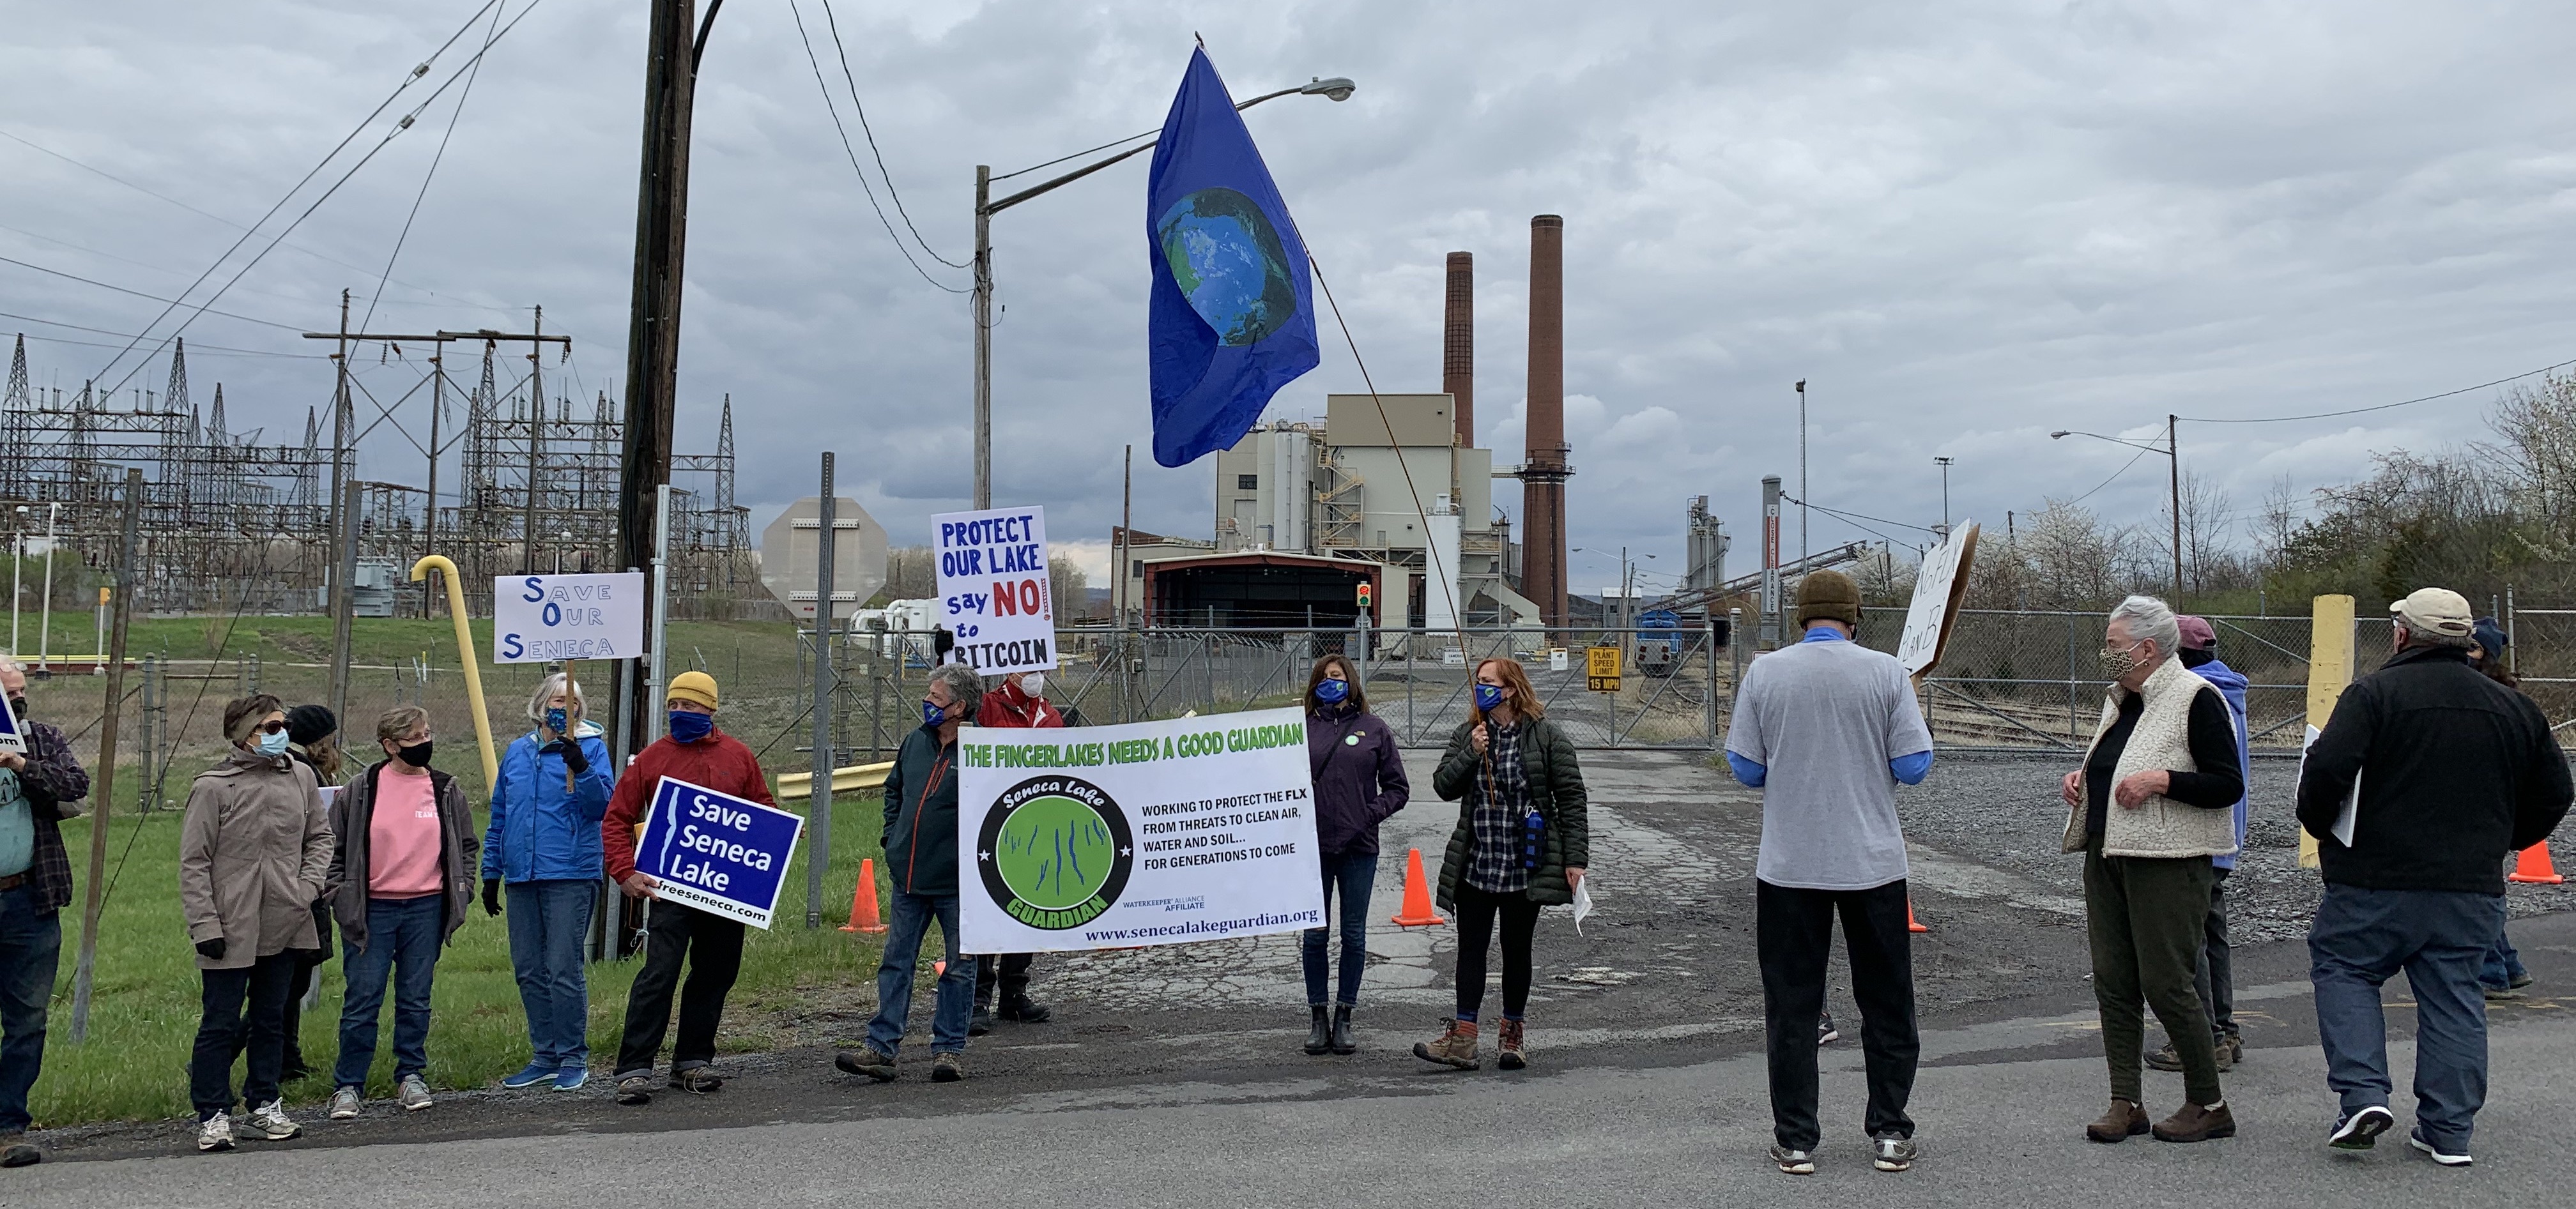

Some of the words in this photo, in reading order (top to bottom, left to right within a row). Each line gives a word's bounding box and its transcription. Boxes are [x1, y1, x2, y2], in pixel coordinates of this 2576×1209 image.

[942, 515, 1033, 547] PROTECT
[942, 549, 983, 577] OUR
[988, 544, 1043, 574] LAKE
[523, 577, 611, 602] SAVE
[947, 593, 988, 614] say
[542, 602, 604, 627] OUR
[1922, 604, 1940, 650] B
[956, 623, 979, 638] to
[502, 633, 615, 659] SENECA
[954, 639, 1048, 669] BITCOIN
[1590, 678, 1601, 689] 15
[1603, 678, 1620, 690] MPH
[963, 743, 992, 768] THE
[995, 742, 1105, 768] FINGERLAKES
[1108, 736, 1160, 765] NEEDS
[1163, 736, 1174, 760] A
[1177, 731, 1224, 759] GOOD
[1227, 722, 1304, 752] GUARDIAN
[1002, 781, 1061, 809] Seneca
[1065, 780, 1105, 807] Lake
[1142, 802, 1197, 817] WORKING
[1199, 799, 1213, 811] TO
[1216, 794, 1262, 809] PROTECT
[1263, 791, 1283, 803] THE
[1285, 788, 1308, 801] FLX
[689, 795, 751, 832] Save
[1144, 821, 1176, 835] FROM
[1179, 816, 1227, 831] THREATS
[1229, 814, 1243, 826] TO
[1246, 809, 1279, 823] CLEAN
[1281, 807, 1301, 819] AIR,
[679, 825, 772, 872] Seneca
[1144, 839, 1182, 853] WATER
[1184, 836, 1208, 848] AND
[1210, 833, 1246, 846] SOIL...
[1145, 858, 1167, 870] FOR
[1170, 849, 1247, 868] GENERATIONS
[1249, 848, 1262, 859] TO
[1265, 843, 1296, 857] COME
[670, 854, 730, 892] Lake
[658, 880, 766, 922] freeseneca.com
[1006, 894, 1108, 929] GUARDIAN
[1165, 902, 1205, 912] AFFILIATE
[1175, 895, 1205, 904] ALLIANCE
[1085, 909, 1318, 942] www.senecalakeguardian.org
